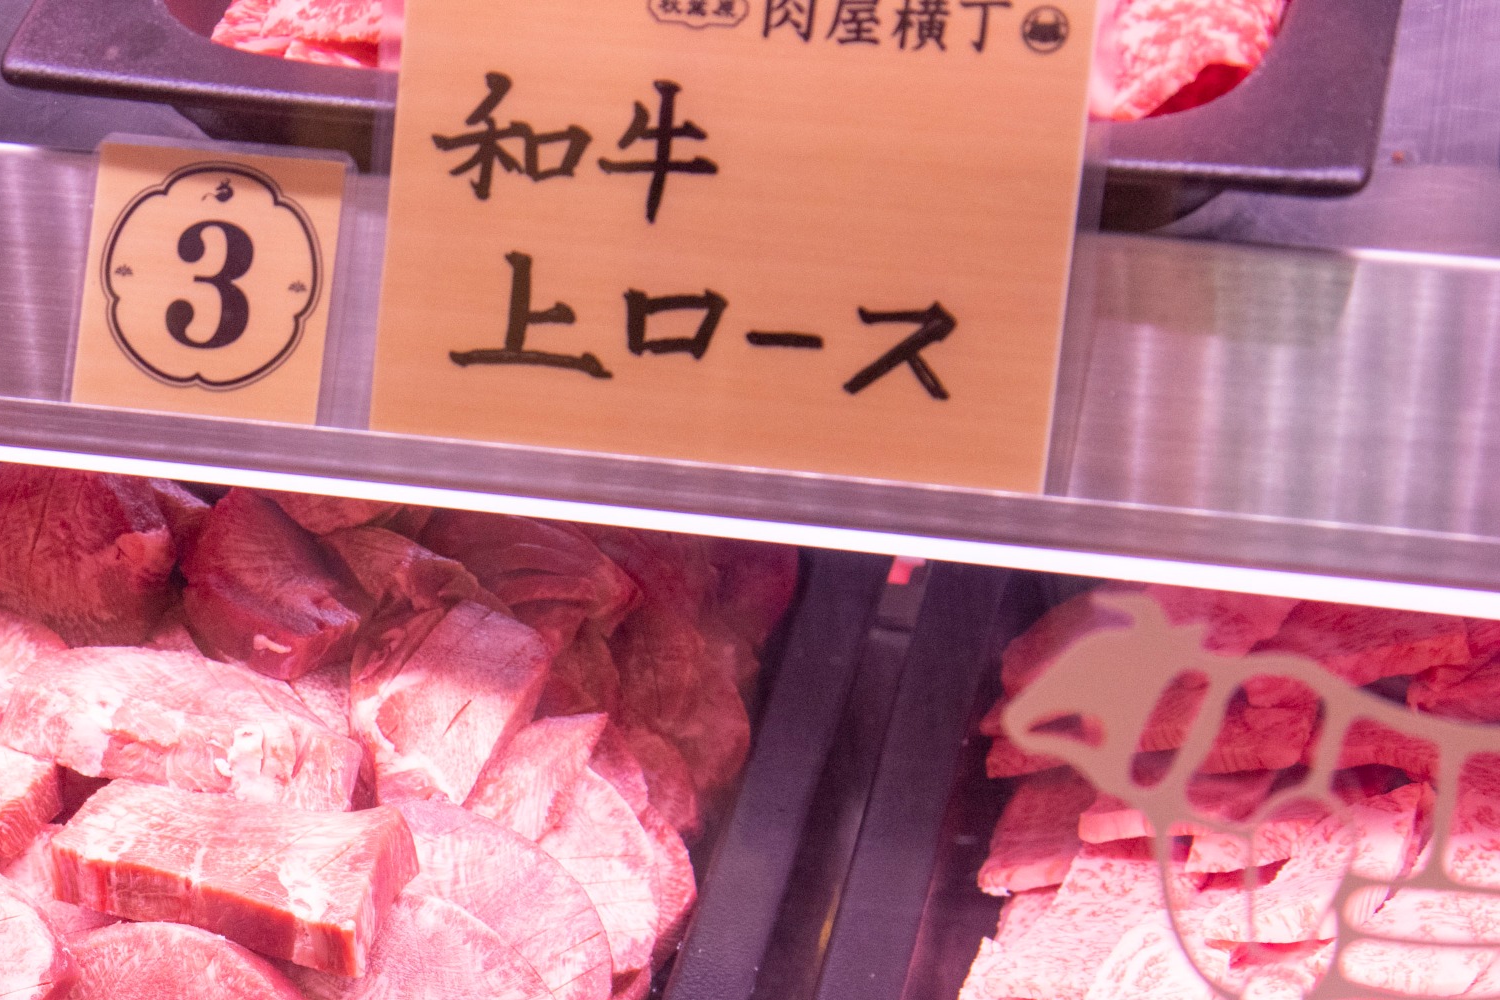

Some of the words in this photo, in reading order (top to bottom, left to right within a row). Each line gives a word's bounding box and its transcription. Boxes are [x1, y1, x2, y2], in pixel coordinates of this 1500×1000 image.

[762, 0, 1012, 53] 肉屋横丁
[432, 72, 719, 224] 和牛
[166, 220, 254, 349] 3
[449, 252, 957, 401] 上ロース
